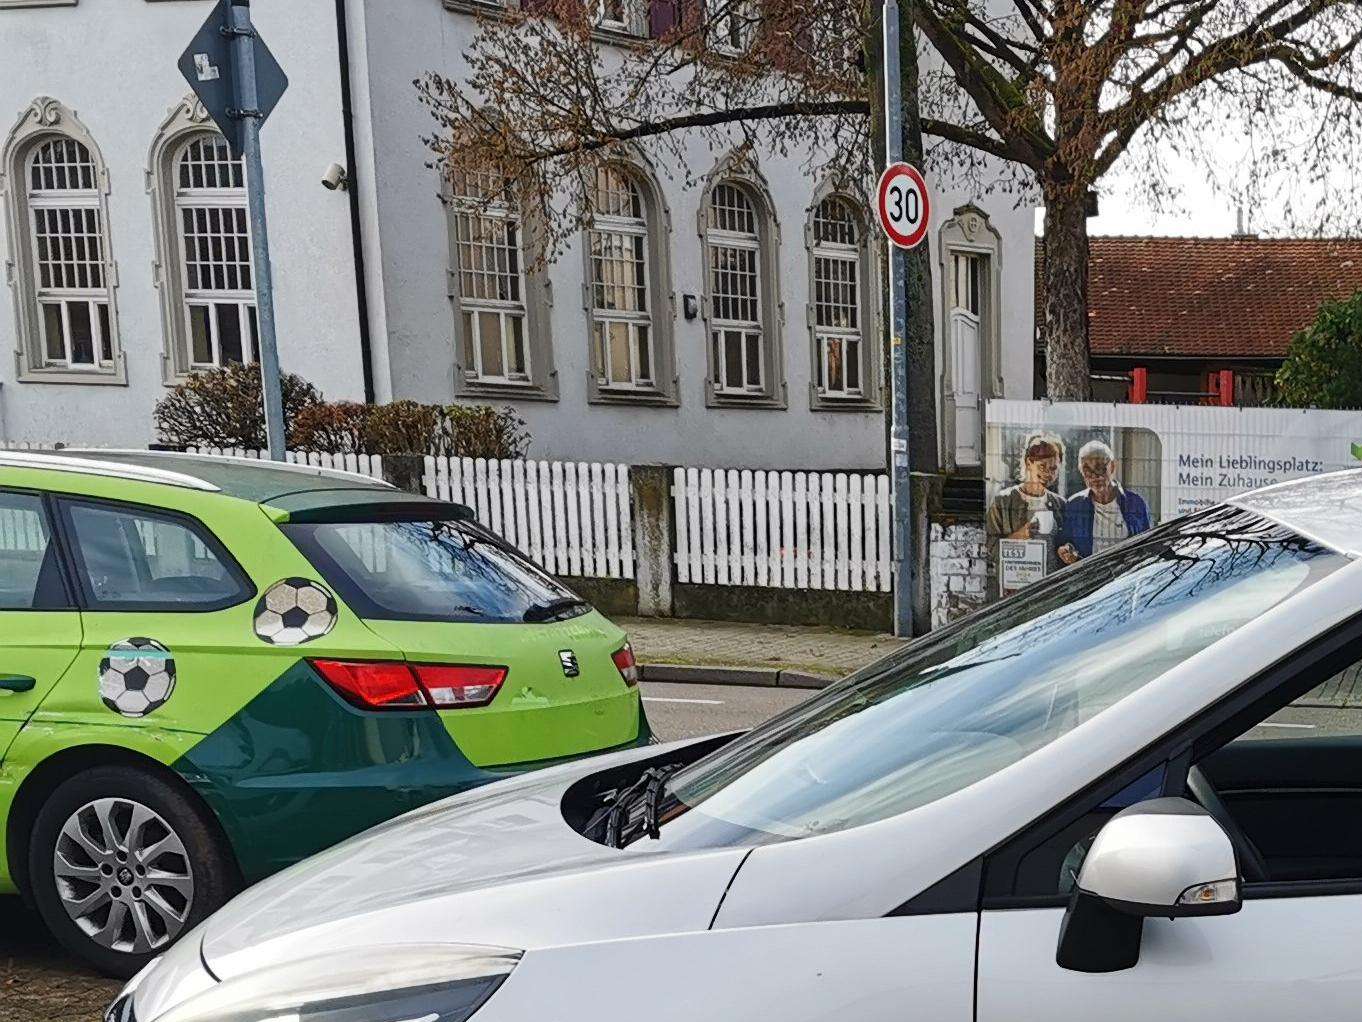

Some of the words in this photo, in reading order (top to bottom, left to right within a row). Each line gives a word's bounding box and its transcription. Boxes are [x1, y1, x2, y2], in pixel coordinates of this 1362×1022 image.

[889, 186, 919, 225] 30
[1178, 453, 1214, 469] Mein
[1219, 454, 1324, 475] Lieblingsplatz:
[1178, 472, 1213, 487] Mein
